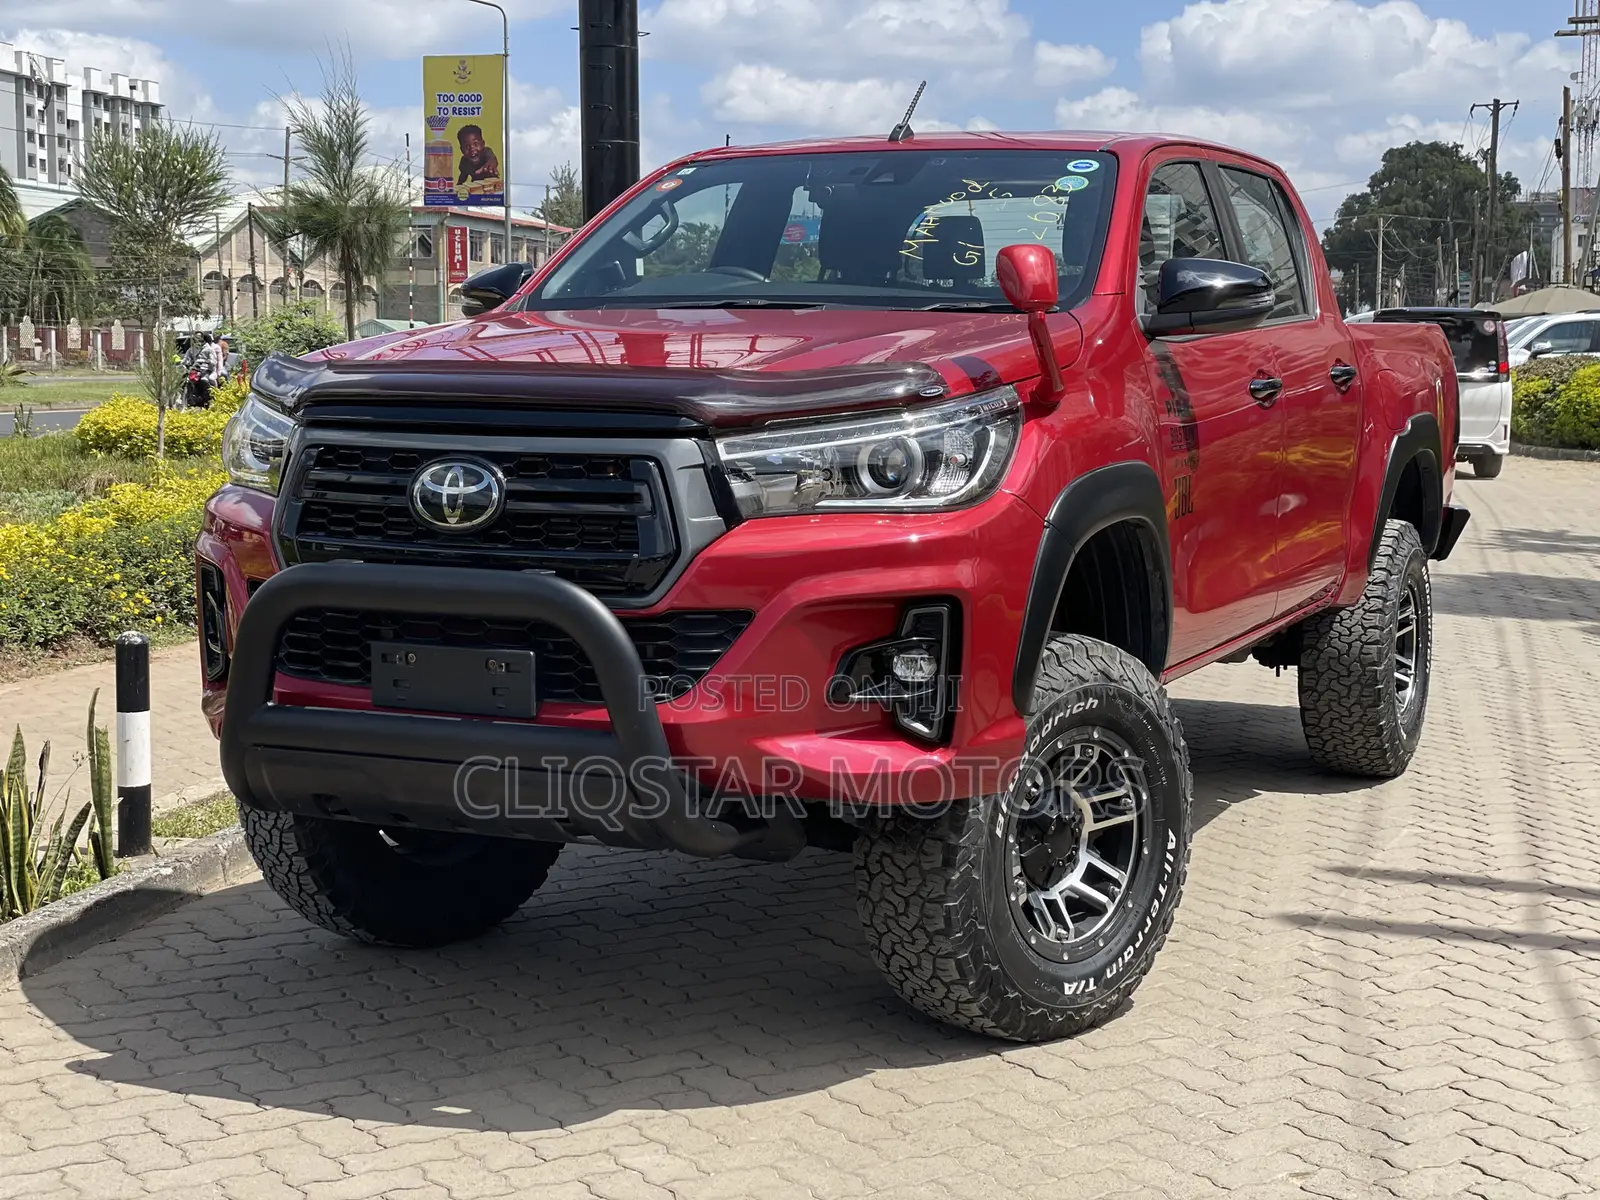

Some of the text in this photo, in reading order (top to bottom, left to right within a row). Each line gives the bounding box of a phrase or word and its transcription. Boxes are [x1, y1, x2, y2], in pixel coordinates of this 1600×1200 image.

[436, 93, 482, 103] TOO GOOD
[436, 106, 482, 116] TO RESIST
[454, 228, 463, 269] UCHUMI
[1174, 474, 1194, 520] JBL
[995, 697, 1099, 839] BFGoodrich
[1106, 828, 1177, 979] All-Terrain
[1063, 977, 1098, 995] T/A
